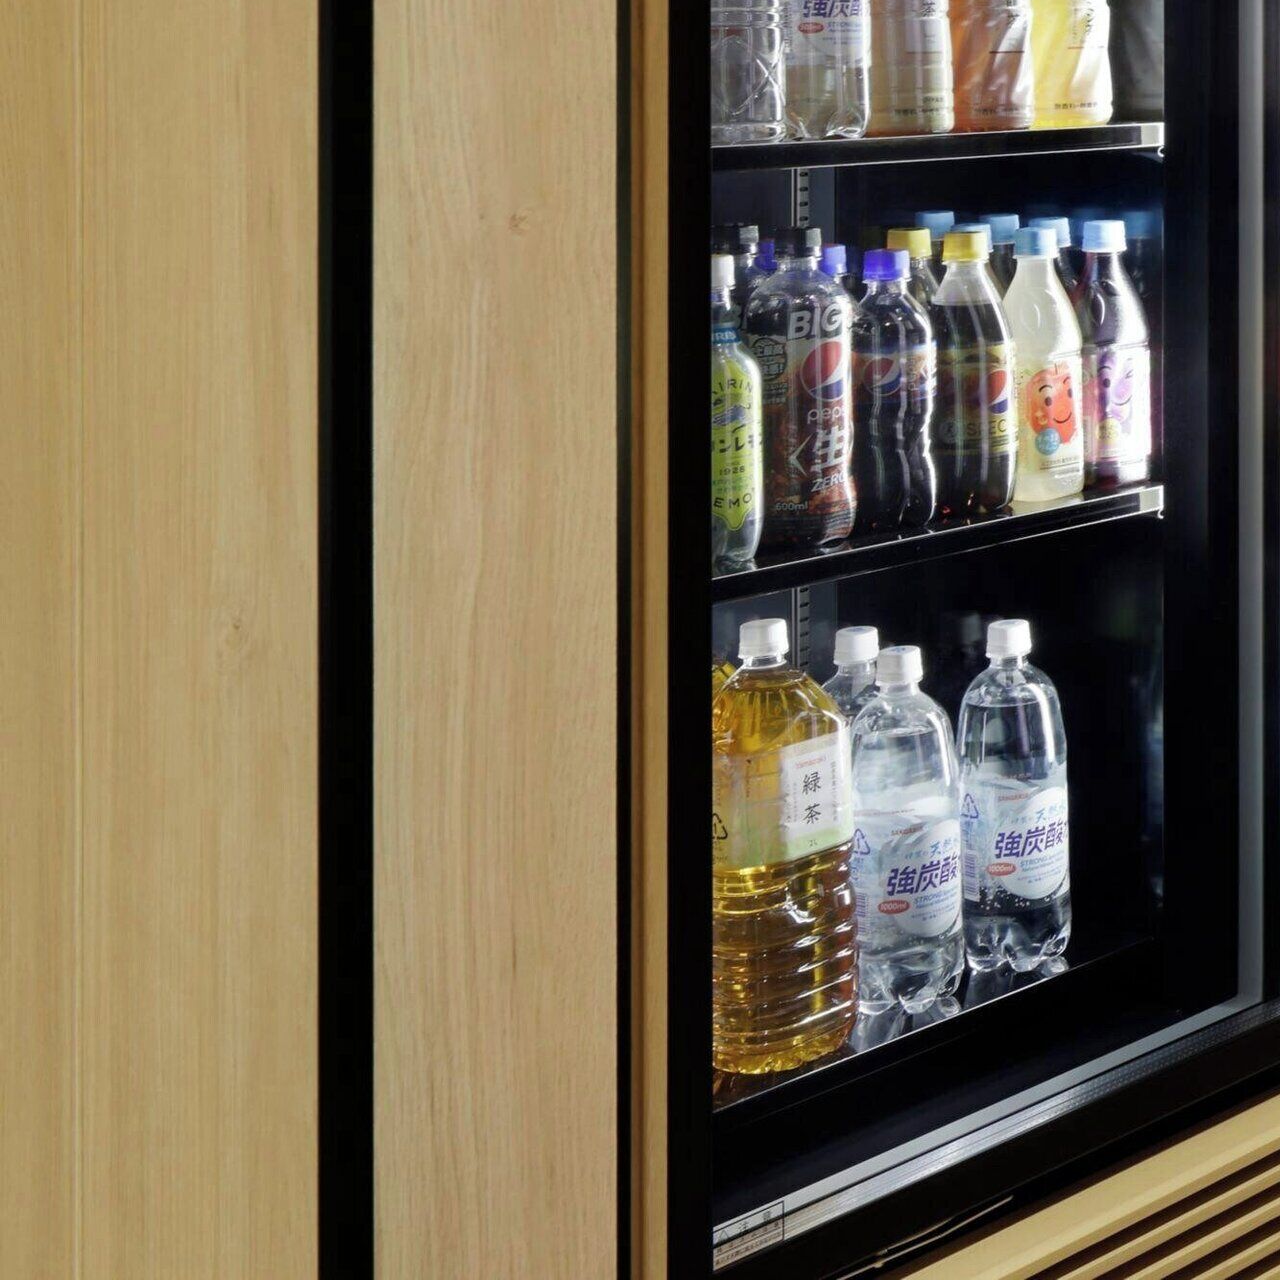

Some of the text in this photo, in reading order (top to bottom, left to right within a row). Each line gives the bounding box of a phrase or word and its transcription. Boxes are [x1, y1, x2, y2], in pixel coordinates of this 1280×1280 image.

[787, 303, 844, 341] BIG
[811, 424, 847, 471] 生
[719, 465, 745, 476] 1928
[713, 491, 753, 509] EMO
[776, 502, 808, 511] 600ml
[801, 771, 822, 826] 緑茶
[995, 819, 1067, 859] 強炭酸
